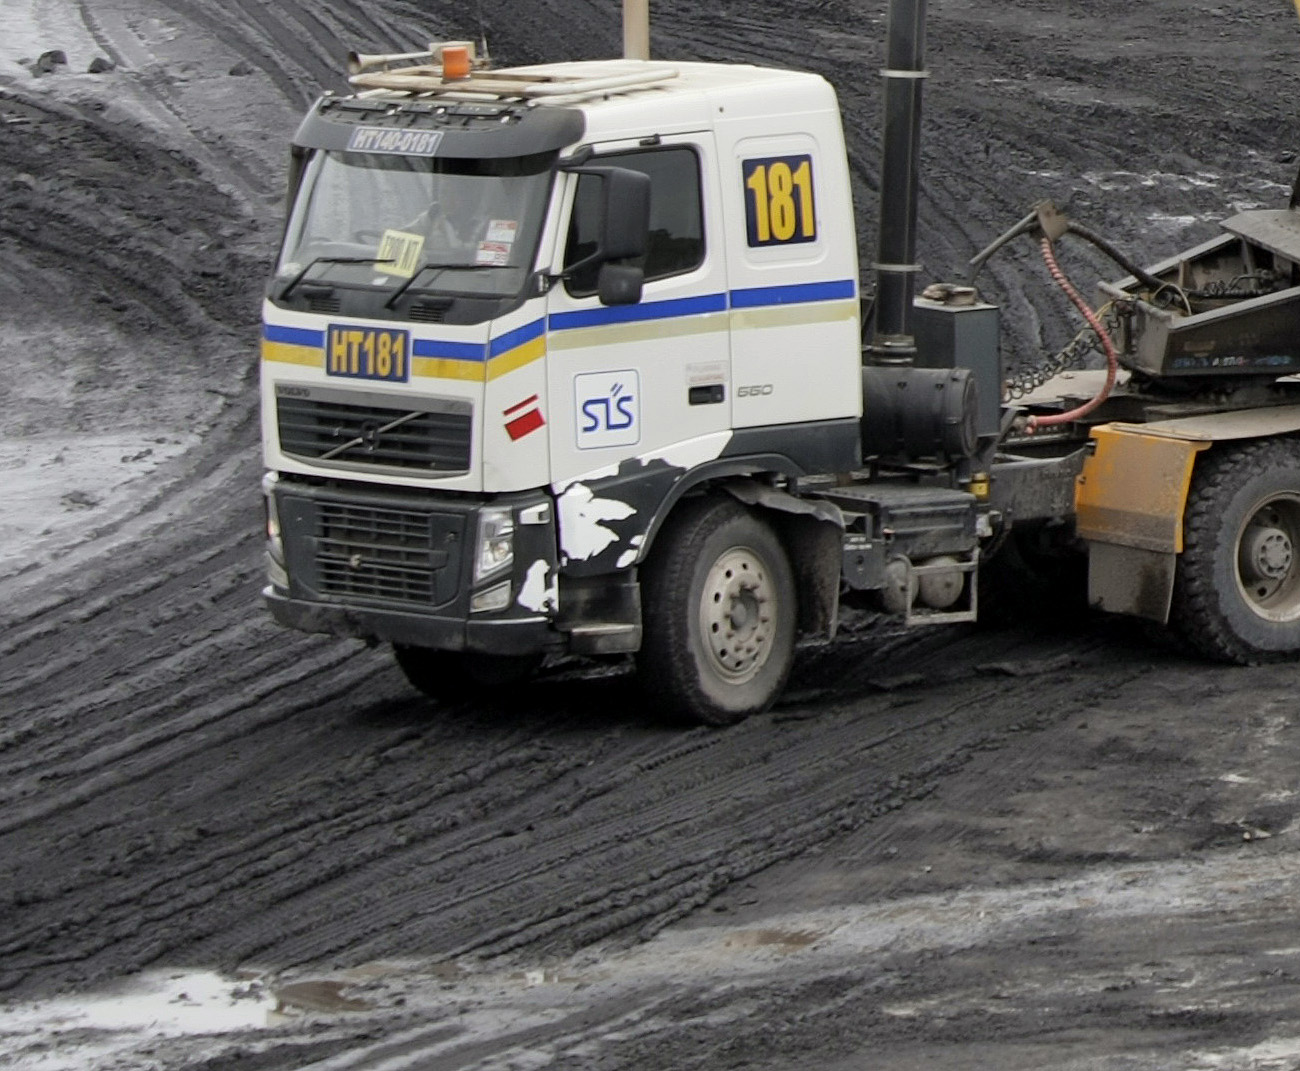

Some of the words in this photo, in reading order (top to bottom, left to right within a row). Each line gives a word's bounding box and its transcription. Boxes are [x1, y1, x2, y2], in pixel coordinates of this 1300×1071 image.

[353, 130, 438, 153] HT140-0181
[747, 161, 815, 241] 181
[331, 330, 405, 377] HT181
[582, 383, 634, 432] SLS
[738, 384, 773, 397] 660
